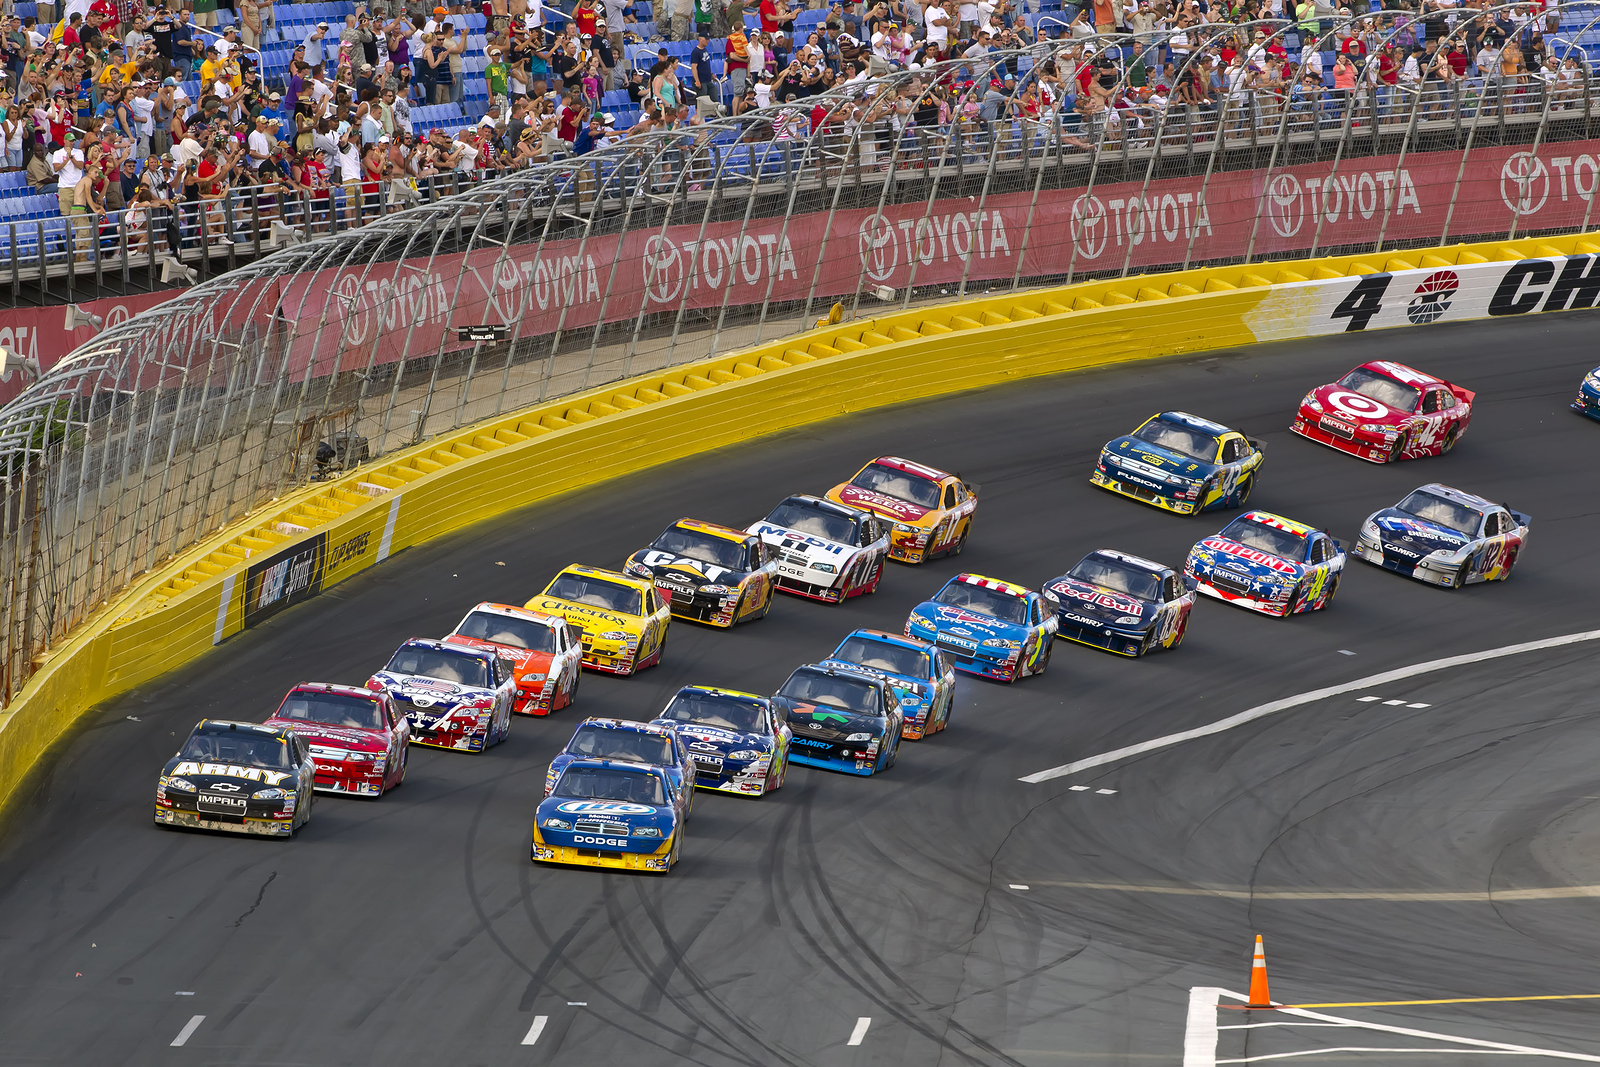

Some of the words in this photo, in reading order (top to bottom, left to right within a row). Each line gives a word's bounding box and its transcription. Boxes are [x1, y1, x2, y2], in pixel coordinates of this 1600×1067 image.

[1305, 170, 1421, 224] TOYOTA
[1109, 192, 1214, 246] TOYOTA
[898, 210, 1011, 266] TOYOTA
[683, 234, 797, 289] TOYOTA
[521, 255, 601, 310] TOYOTA
[366, 273, 449, 331] TOYOTA
[1330, 272, 1393, 332] 4
[1320, 416, 1355, 434] IMPALA
[1418, 416, 1442, 447] 42
[1117, 470, 1163, 490] FUSION
[1221, 465, 1242, 497] 43
[758, 526, 844, 555] Mobil
[1407, 530, 1438, 541] ENERGY
[1384, 543, 1420, 559] CAMRY
[642, 550, 732, 583] CAT
[779, 565, 805, 577] DGE
[1213, 568, 1251, 586] IMPALA
[654, 580, 695, 596] IMPALA
[1050, 582, 1099, 603] Red
[1095, 594, 1144, 616] Bull
[541, 600, 627, 626] Cheerios
[1065, 612, 1104, 628] CAMRY
[964, 622, 996, 637] PARTS
[937, 633, 978, 650] IMPALA
[405, 712, 441, 723] AMRY
[320, 732, 359, 744] FORCES
[791, 736, 834, 750] CAMRY
[171, 762, 292, 786] ARMY
[198, 795, 247, 807] IMPALA
[573, 835, 628, 847] DODGE
